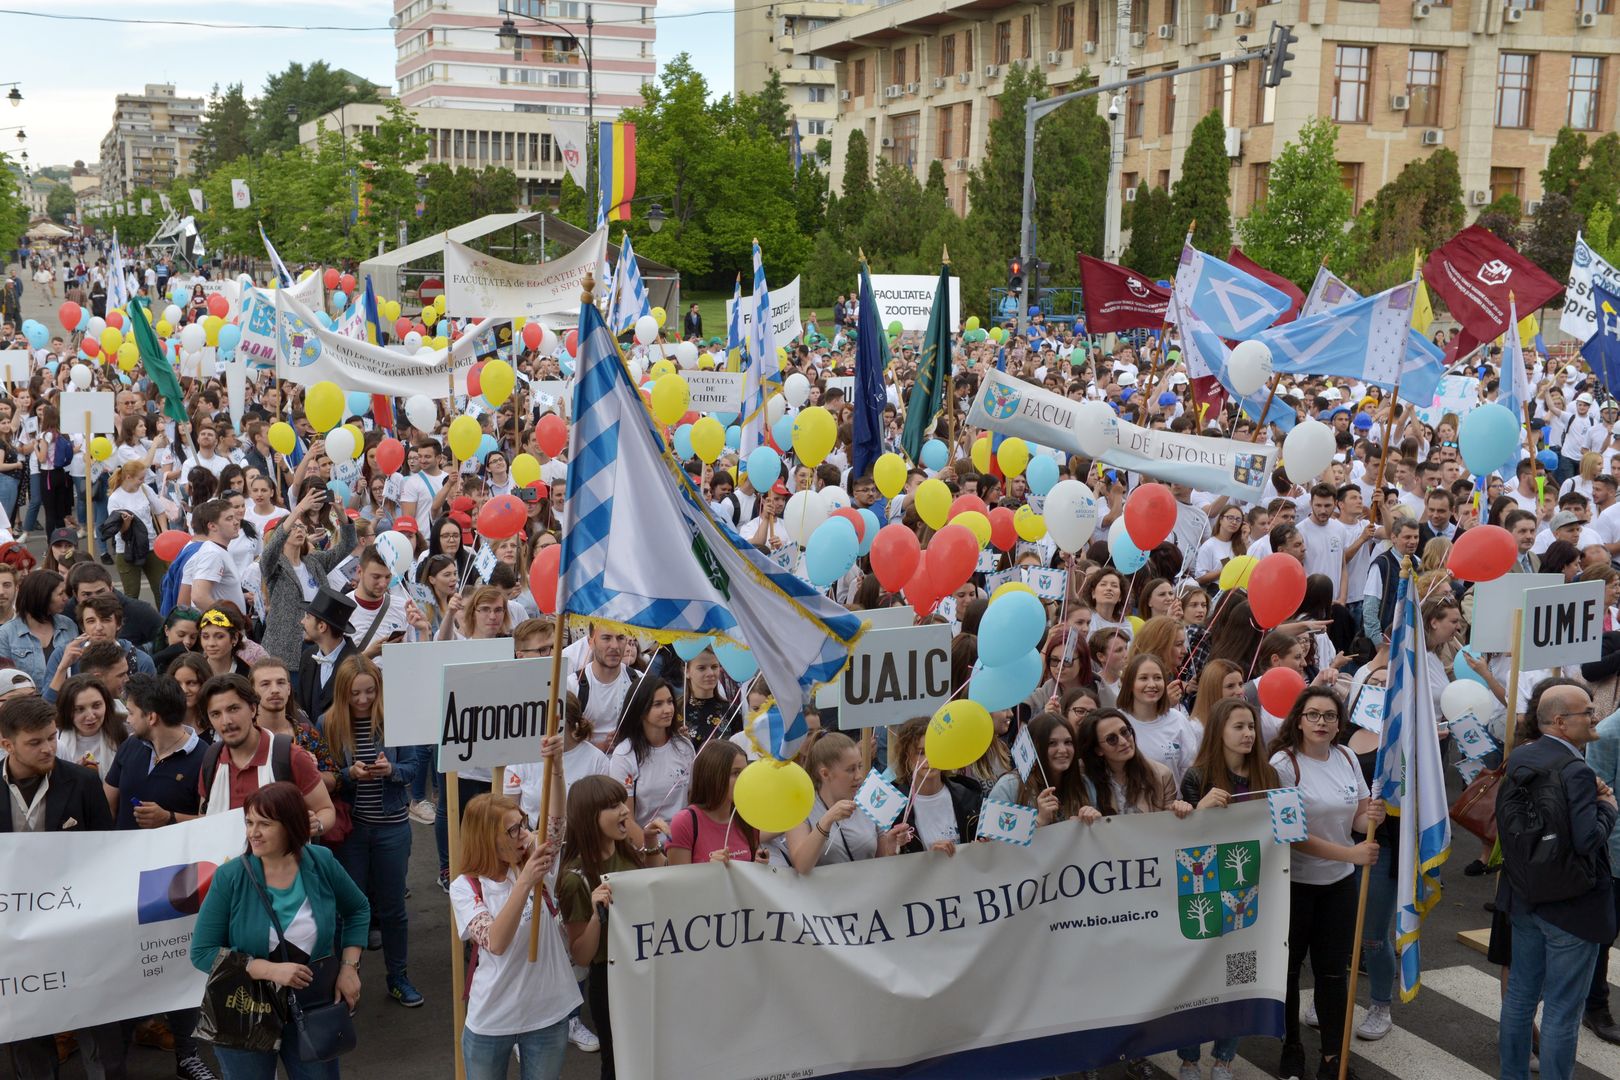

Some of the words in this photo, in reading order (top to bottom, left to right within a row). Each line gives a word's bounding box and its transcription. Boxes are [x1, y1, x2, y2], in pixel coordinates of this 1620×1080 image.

[453, 273, 513, 288] FACULTATEA
[514, 279, 525, 287] de
[873, 289, 932, 301] FACULTATEA
[885, 305, 932, 316] ZOOTEHN
[433, 355, 474, 375] GEOOGIE
[687, 376, 735, 385] FACULTATEA
[692, 393, 728, 403] CHIMIE
[1131, 432, 1150, 454] DE
[1160, 441, 1226, 467] ISTORIE
[1533, 599, 1597, 648] U.M.F.
[844, 648, 950, 706] U.A.I.C
[631, 908, 895, 962] FACULTATEA
[902, 895, 966, 938] DE
[973, 856, 1162, 925] BIOLOGIE
[1049, 908, 1160, 932] www.bio.uaic.ro
[141, 953, 159, 966] de
[161, 947, 187, 962] Arte
[1174, 996, 1220, 1011] www.uaic.ro
